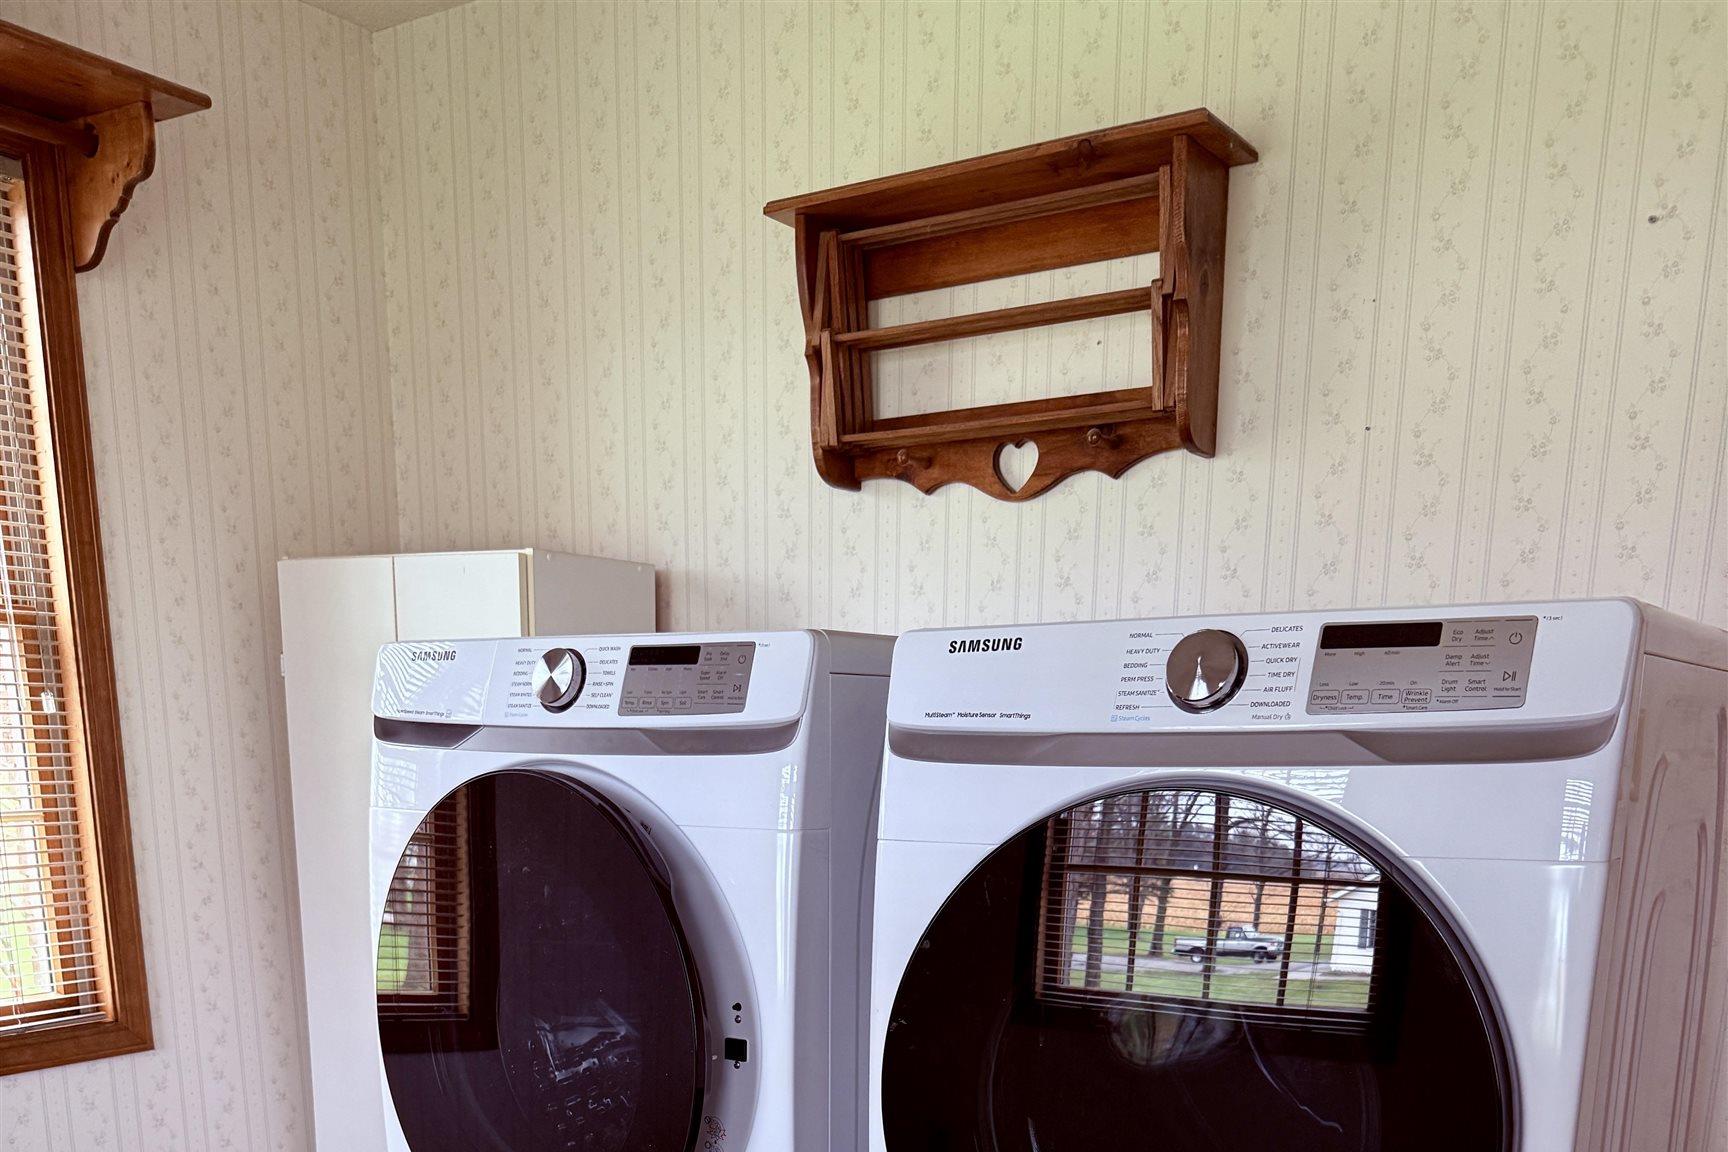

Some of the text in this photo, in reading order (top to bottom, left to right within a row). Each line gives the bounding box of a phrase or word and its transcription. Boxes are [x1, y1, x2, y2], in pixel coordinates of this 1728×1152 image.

[1271, 625, 1303, 633] DELICATES
[949, 637, 1023, 654] SAMSUNG
[411, 650, 457, 661] SAMSUNG
[1313, 694, 1337, 702] Dryness
[999, 712, 1031, 720] SmartThings
[1272, 713, 1283, 721] Dry
